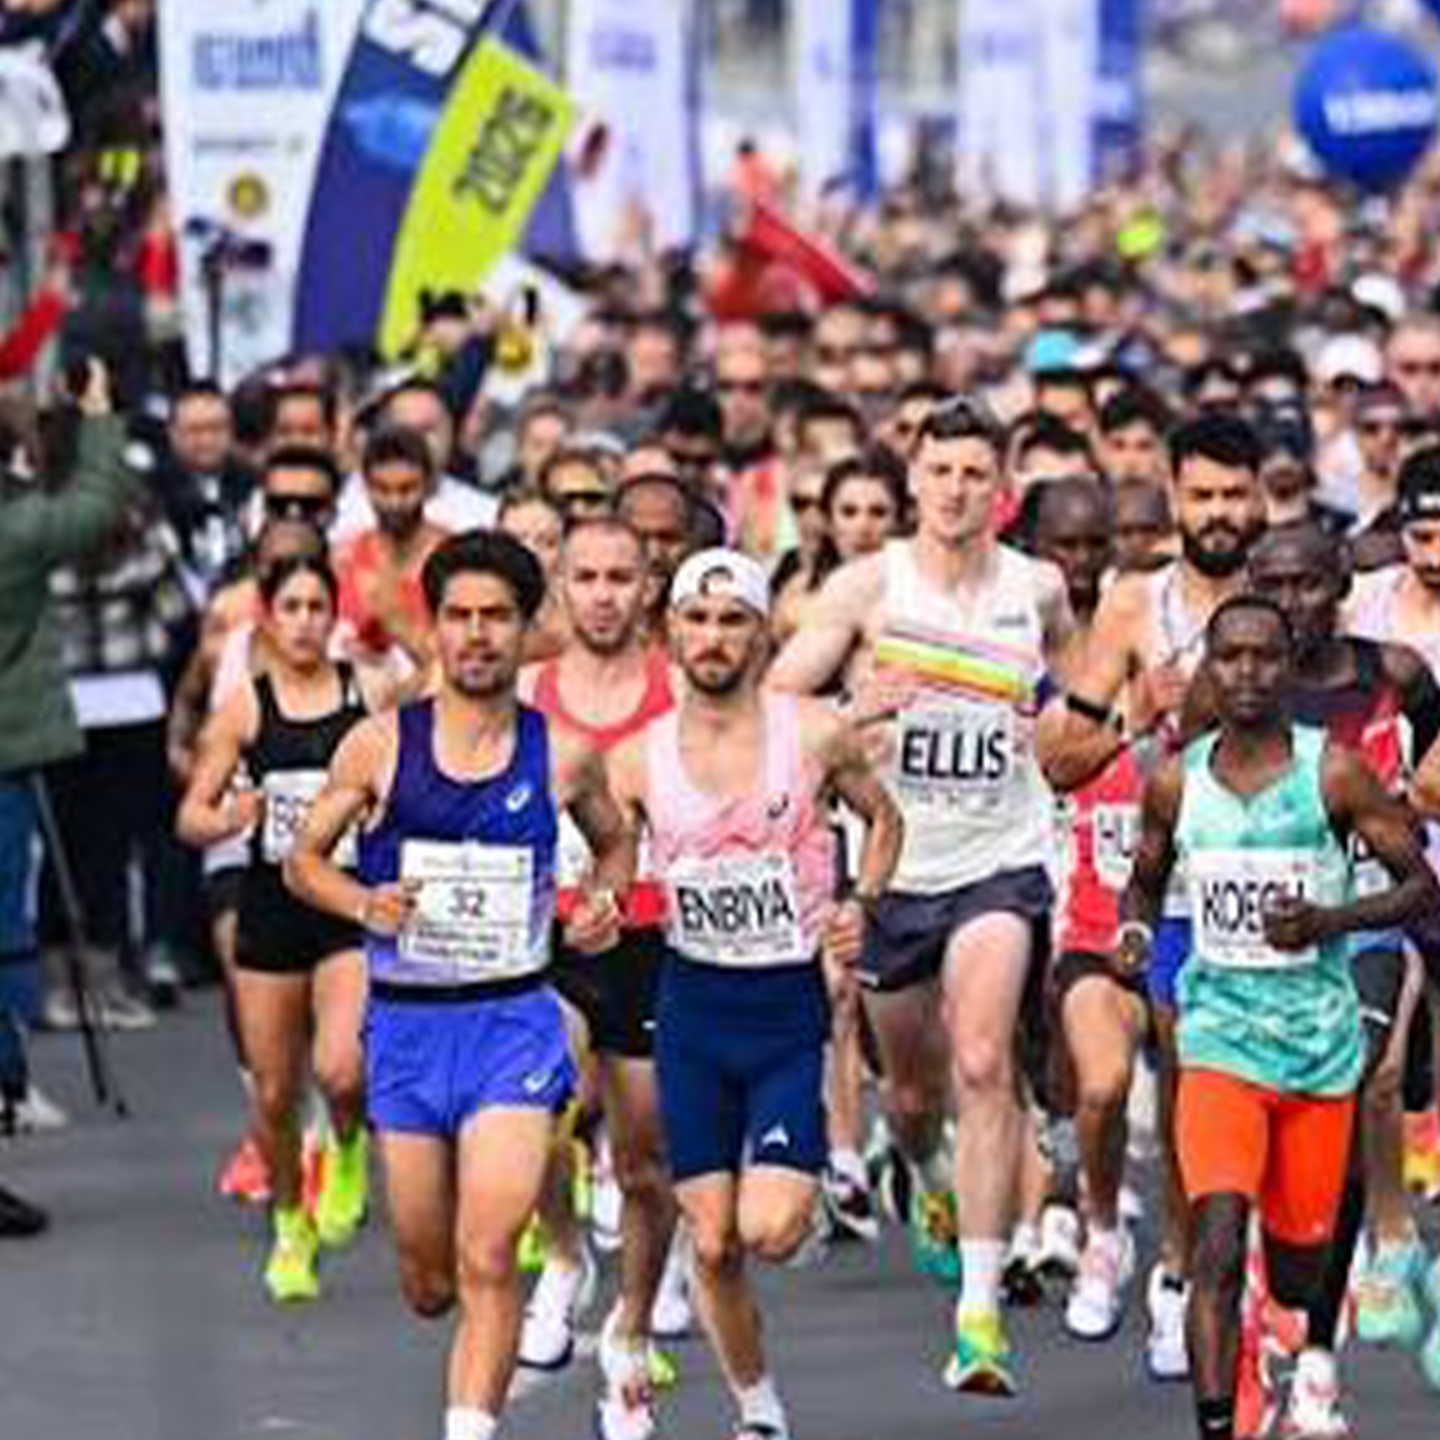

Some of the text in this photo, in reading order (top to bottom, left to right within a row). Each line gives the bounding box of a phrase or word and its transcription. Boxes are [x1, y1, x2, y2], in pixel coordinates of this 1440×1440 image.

[901, 727, 1008, 780] ELLIS
[449, 887, 487, 917] 32
[677, 878, 794, 932] ENBIYA
